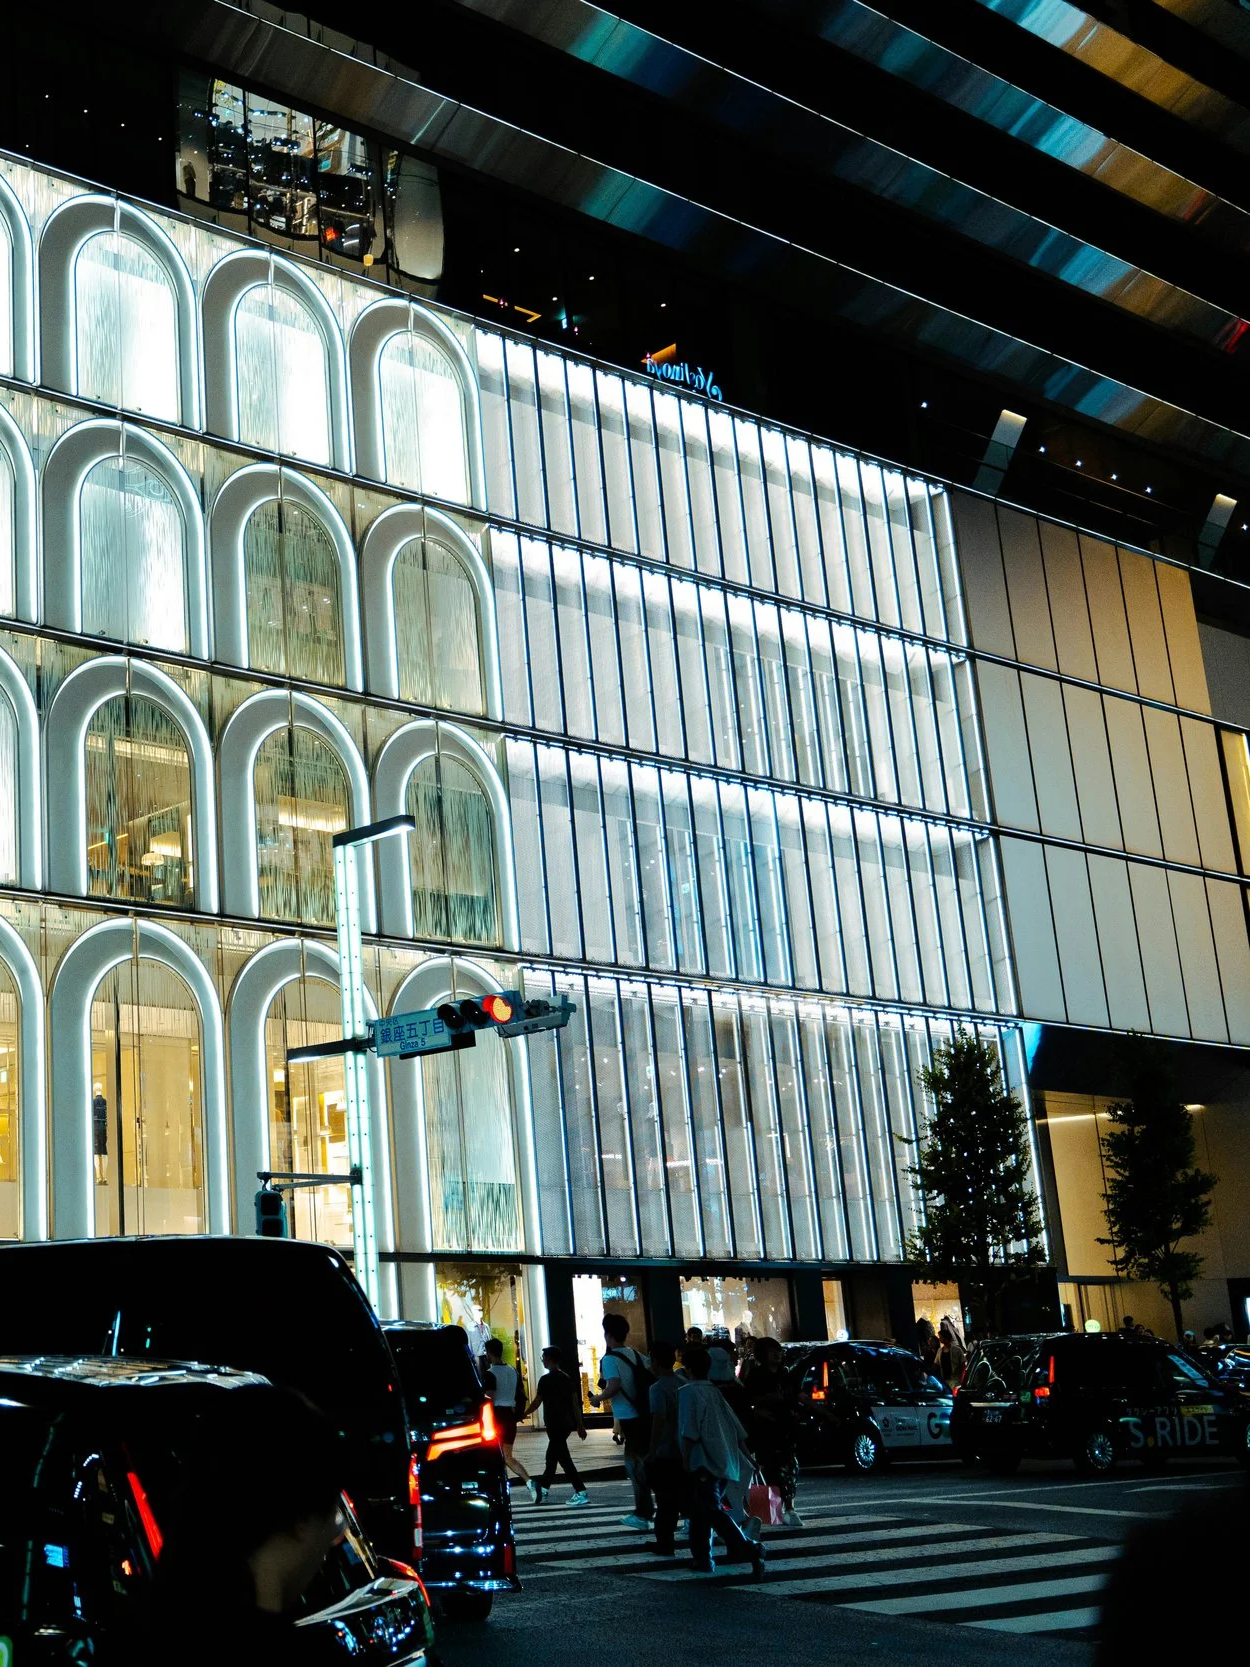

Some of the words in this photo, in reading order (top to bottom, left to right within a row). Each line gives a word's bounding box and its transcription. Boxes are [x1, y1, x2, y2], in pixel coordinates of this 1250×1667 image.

[380, 1018, 444, 1044] 銀座五丁目
[399, 1040, 418, 1051] Ginza
[420, 1037, 426, 1046] 5
[1124, 1415, 1220, 1449] S.RIDE
